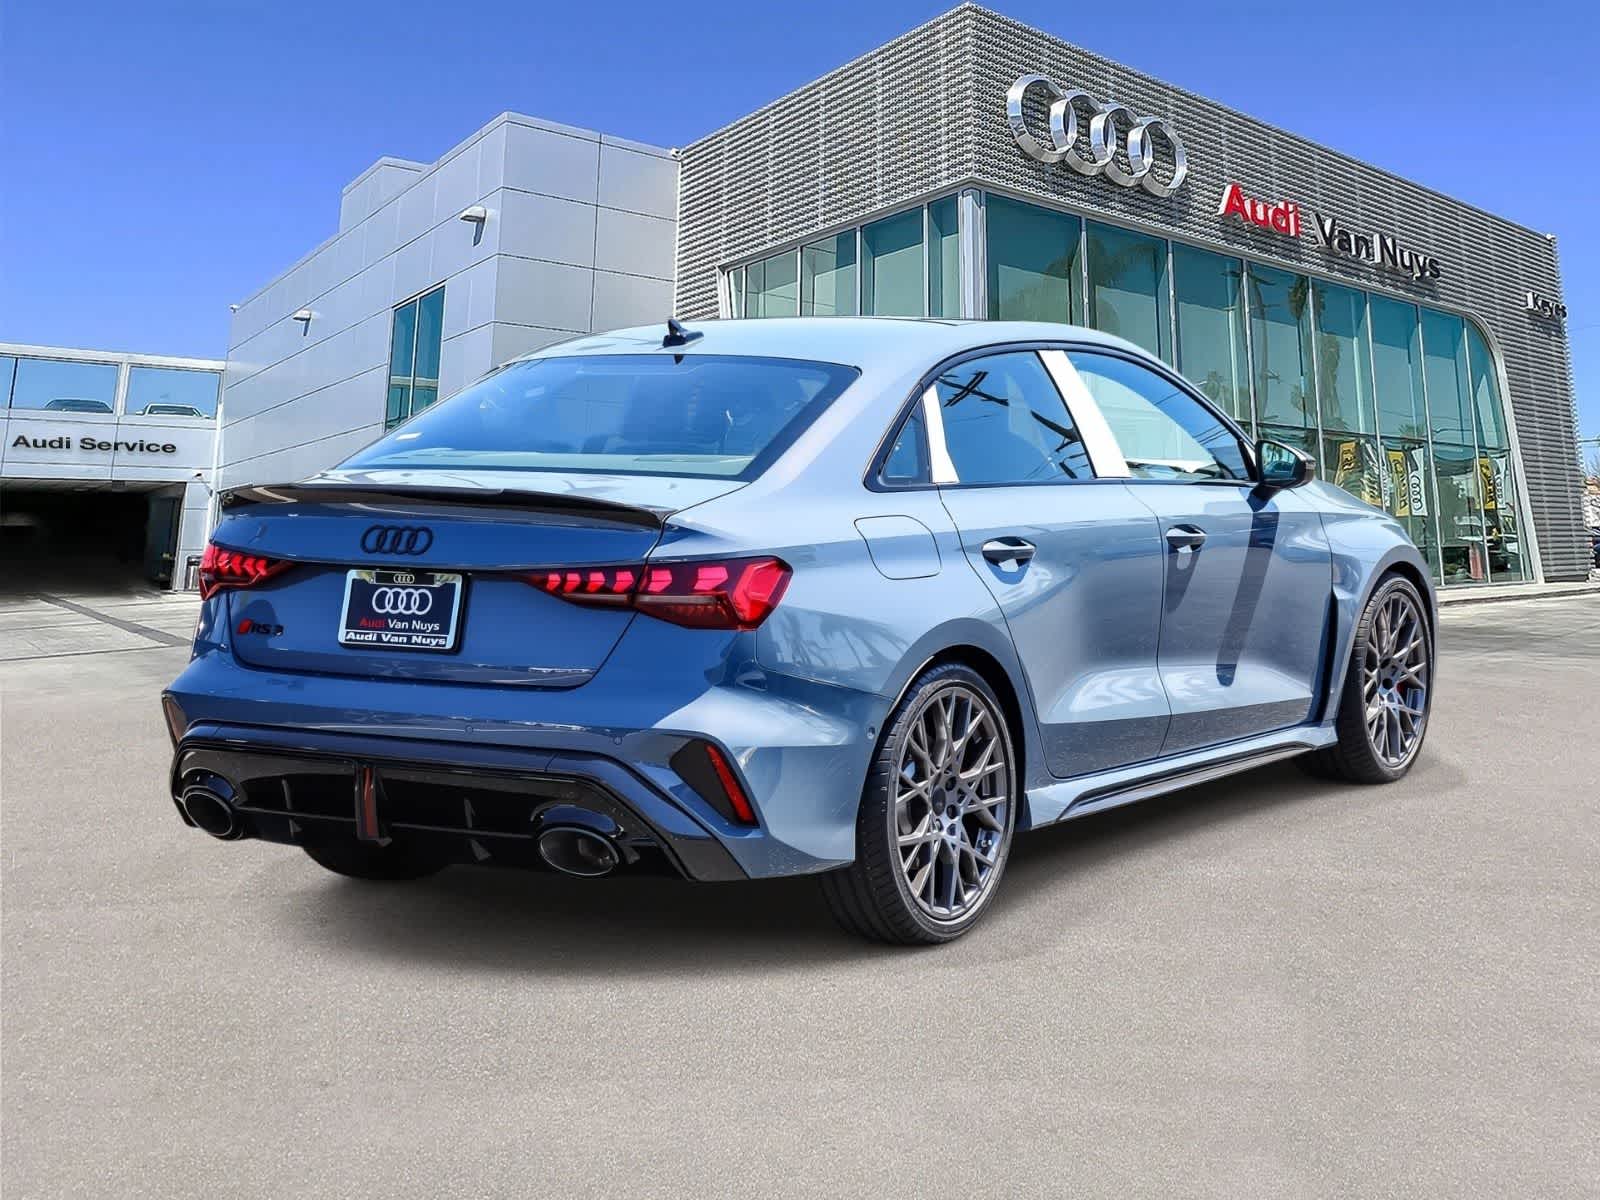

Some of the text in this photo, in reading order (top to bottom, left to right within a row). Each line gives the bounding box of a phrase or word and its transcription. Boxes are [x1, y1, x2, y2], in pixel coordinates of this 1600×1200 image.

[1217, 183, 1441, 281] Audi Van Nuys
[12, 435, 177, 454] Audi Service
[359, 617, 440, 632] Audi Van Nuys
[345, 631, 446, 647] Audi Van Nuys
